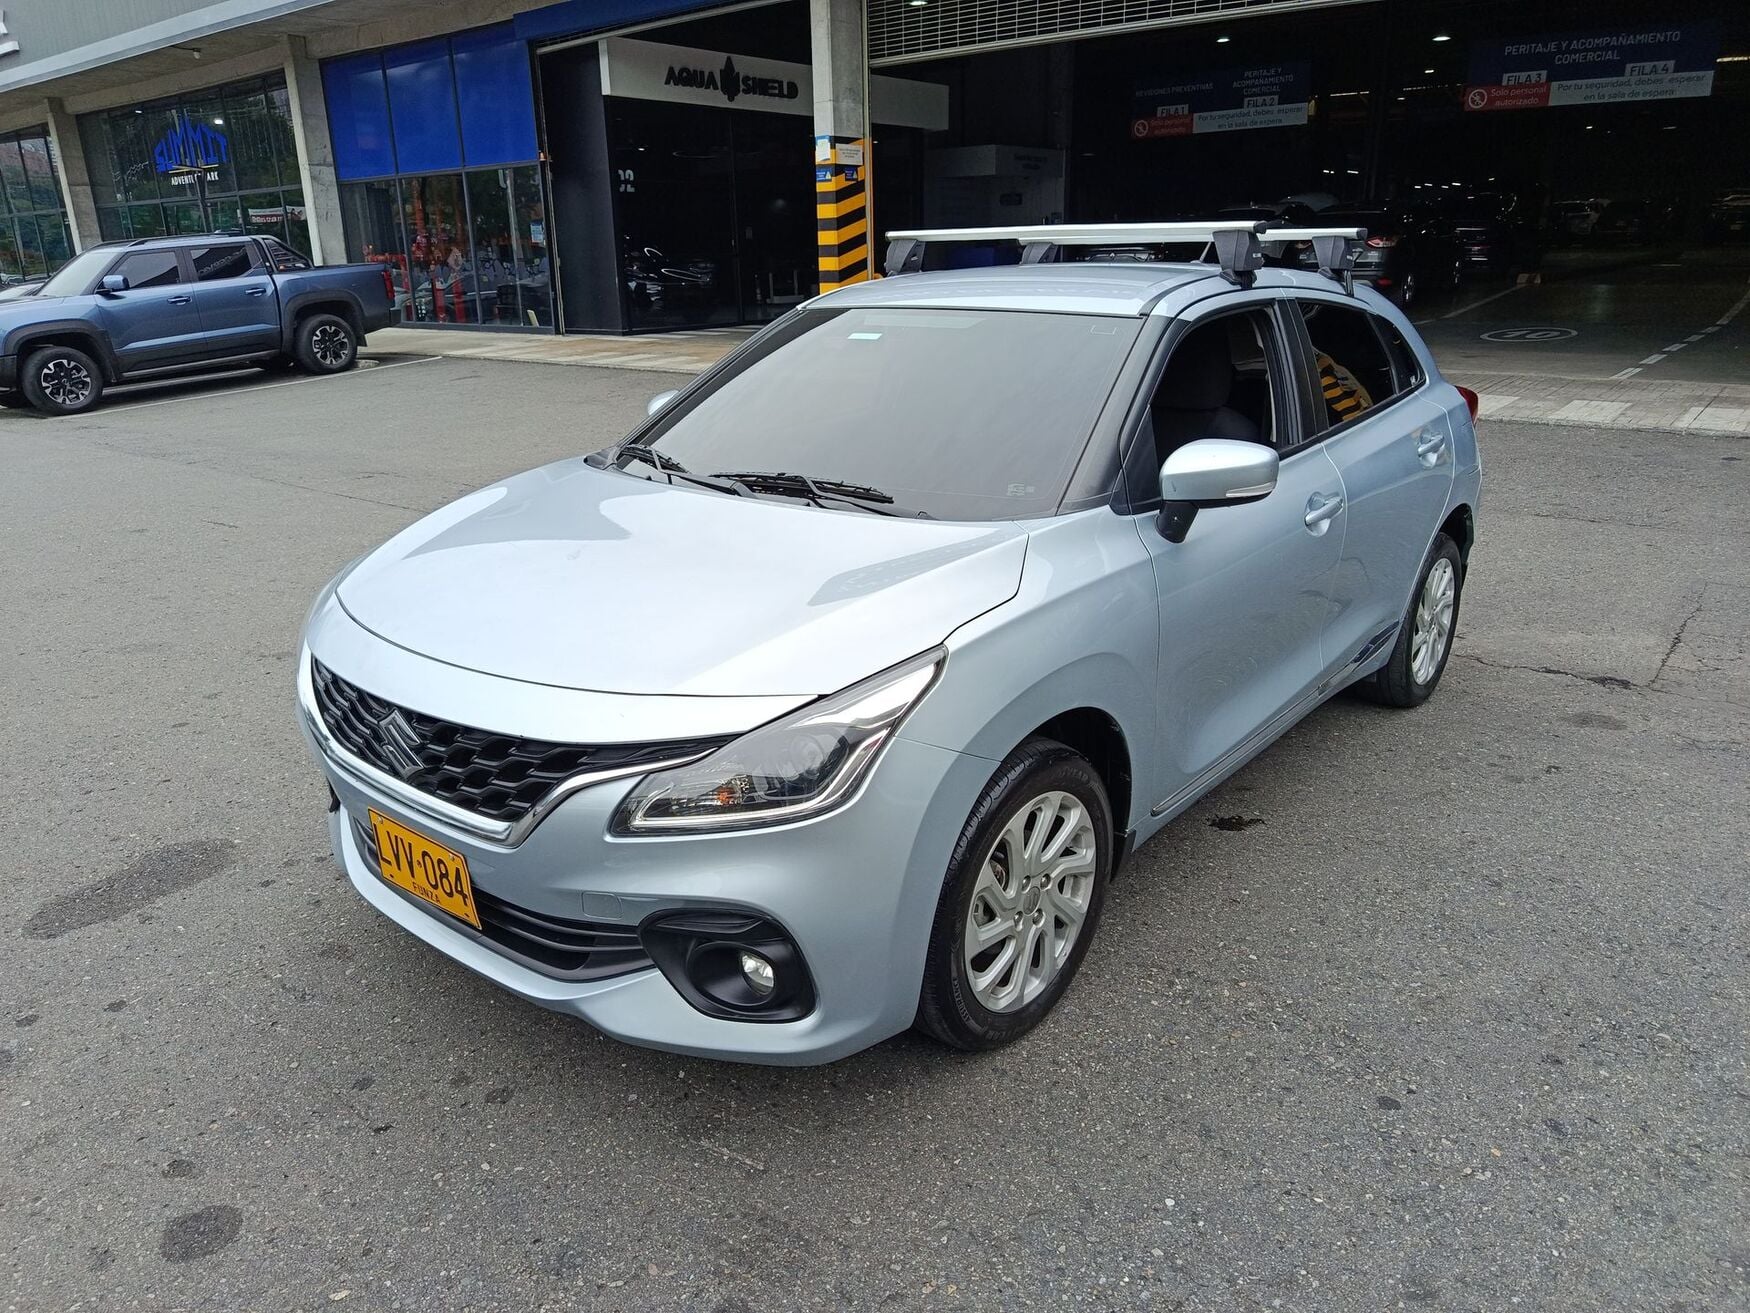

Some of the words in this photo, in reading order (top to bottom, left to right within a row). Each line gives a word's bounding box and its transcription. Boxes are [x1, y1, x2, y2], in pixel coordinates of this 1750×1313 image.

[1504, 41, 1559, 56] PERITAJE
[1560, 40, 1569, 51] Y
[1569, 31, 1681, 51] ACOMPAÑAMIENTO
[1554, 50, 1621, 64] COMERCIAL
[1630, 64, 1658, 76] FILA
[1660, 63, 1669, 74] 4
[664, 65, 719, 90] AQUA
[741, 75, 798, 99] SHIELD
[1506, 74, 1532, 85] FILA
[1535, 73, 1542, 83] 3
[1491, 88, 1509, 97] Solo
[1510, 86, 1547, 97] personal
[1557, 83, 1571, 91] Por
[1247, 99, 1267, 108] FILA
[1269, 97, 1275, 106] 2
[154, 114, 228, 173] SUMMIT
[412, 881, 441, 904] FUNZA
